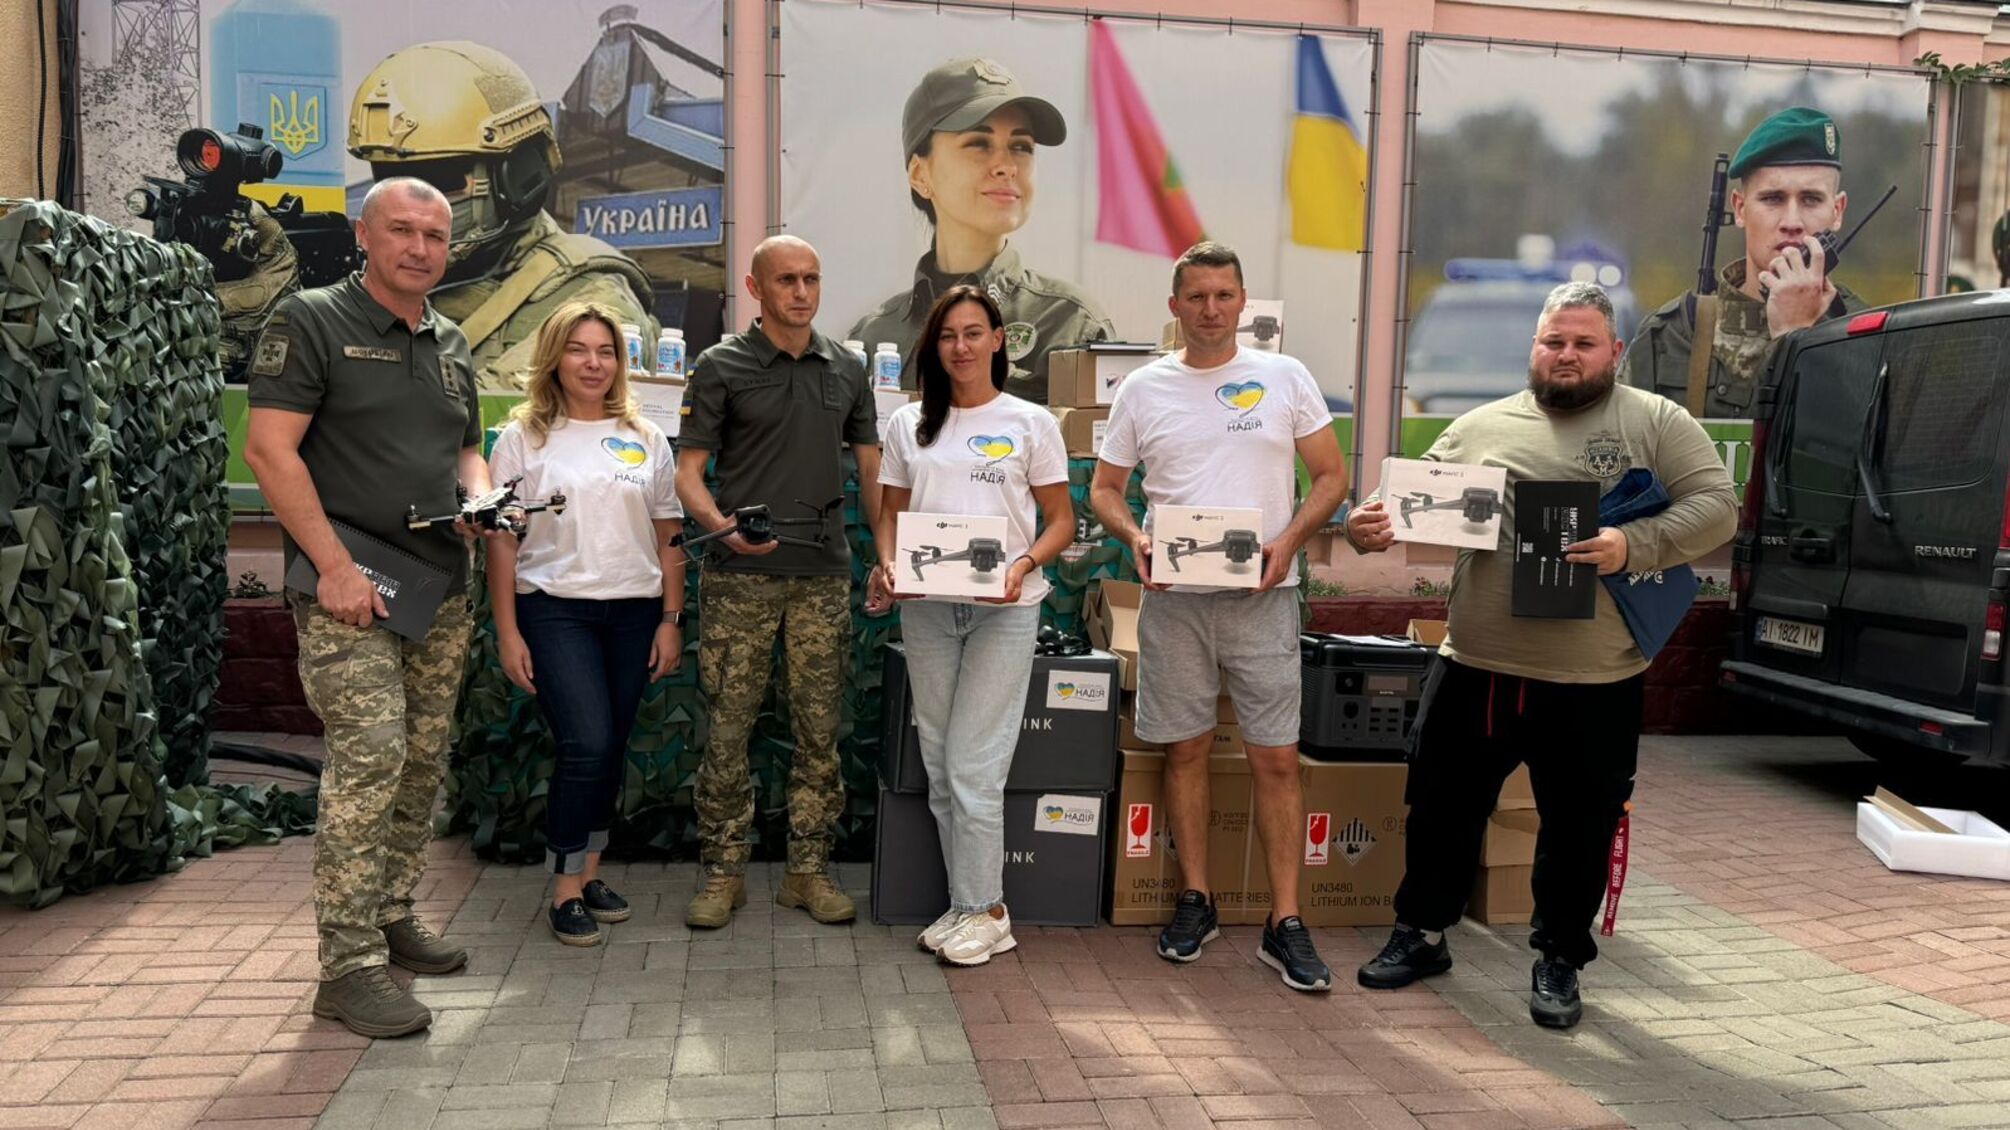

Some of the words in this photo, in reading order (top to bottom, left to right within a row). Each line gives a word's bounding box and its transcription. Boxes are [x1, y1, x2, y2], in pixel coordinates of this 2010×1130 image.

[1227, 421, 1263, 433] НАДІЯ
[1914, 545, 1977, 559] RENAULT
[1777, 622, 1801, 644] 1822
[1311, 883, 1353, 893] UN3480
[1311, 896, 1357, 907] LITHIUM
[1360, 896, 1380, 906] ION
